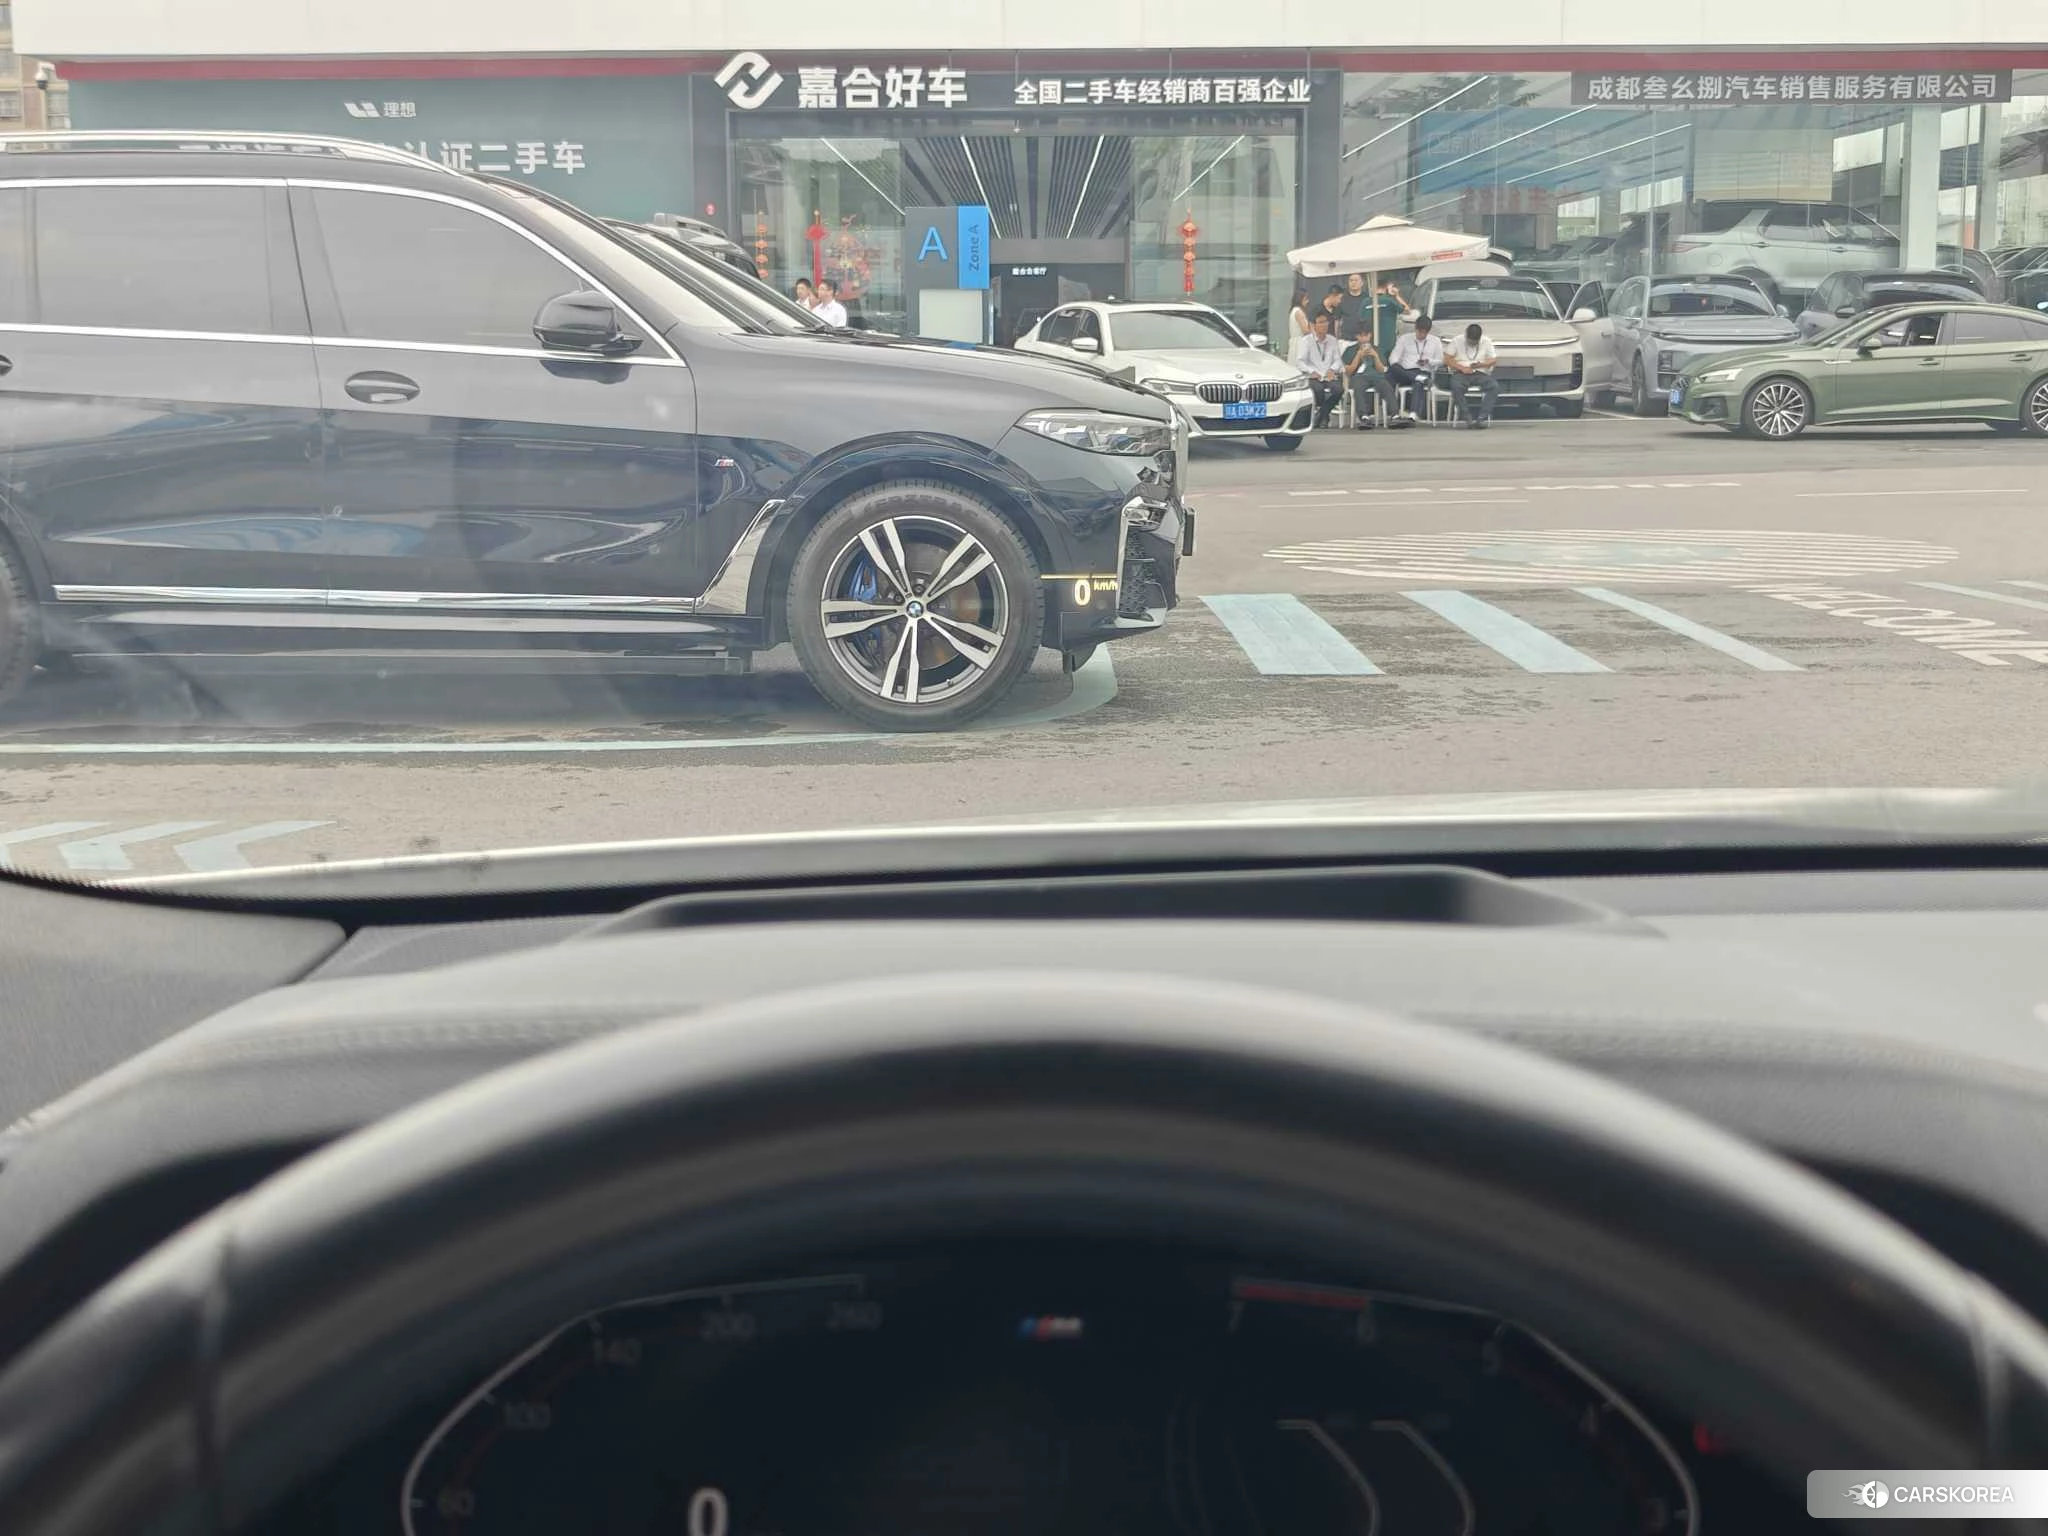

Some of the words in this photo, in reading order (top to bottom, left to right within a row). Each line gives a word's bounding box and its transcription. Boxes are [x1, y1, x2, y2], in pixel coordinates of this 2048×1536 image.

[797, 66, 967, 108] 嘉合好车
[1014, 78, 1311, 105] 全国二手车经销商百强企业
[383, 102, 417, 118] 理想
[918, 226, 949, 261] A
[968, 237, 980, 272] Zone
[1074, 579, 1091, 606] 0
[1093, 580, 1118, 591] km/h
